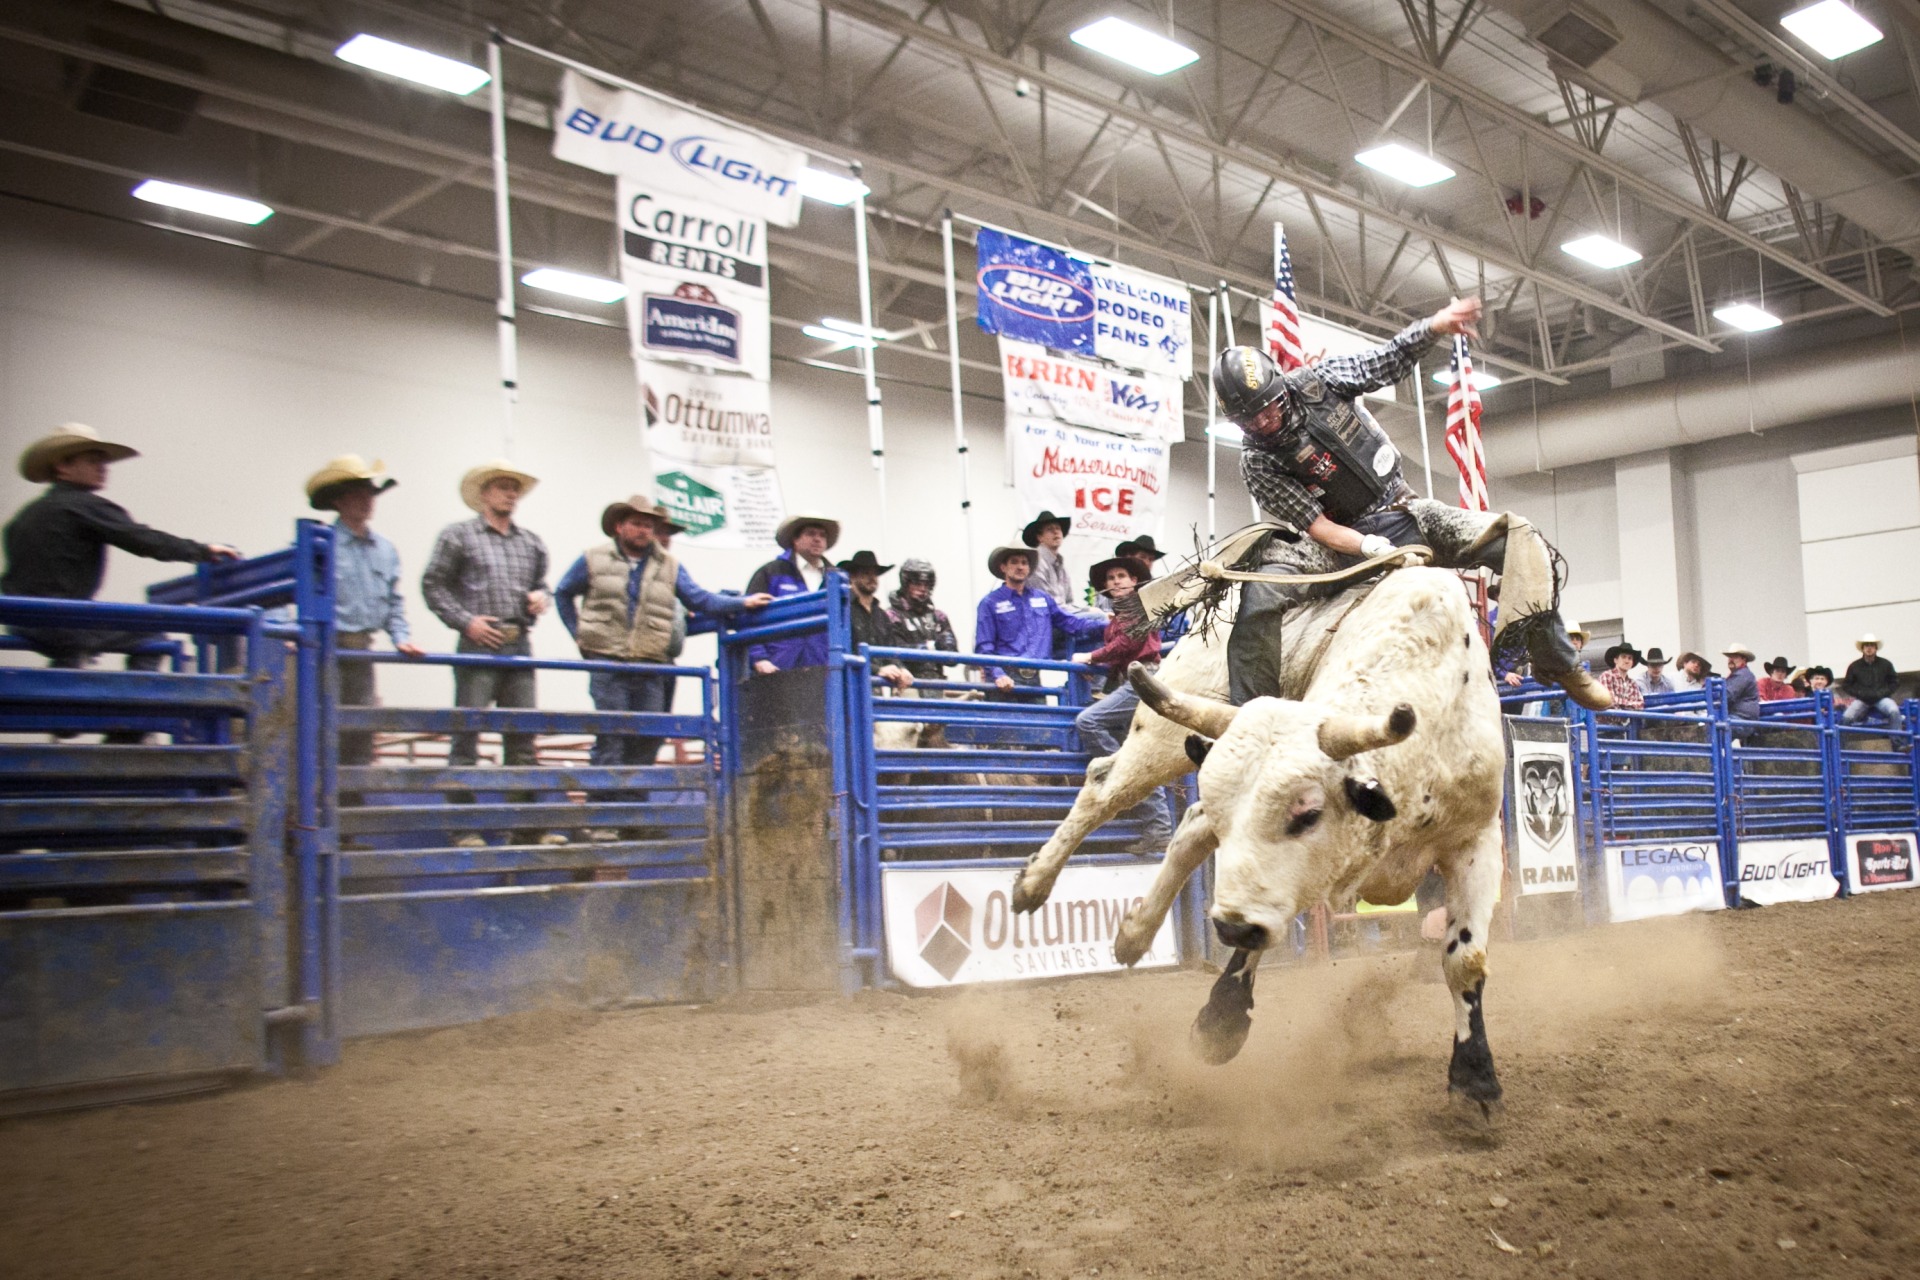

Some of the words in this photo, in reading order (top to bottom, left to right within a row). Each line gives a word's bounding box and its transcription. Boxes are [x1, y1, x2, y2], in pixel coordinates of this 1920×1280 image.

[565, 108, 665, 154] BUD
[689, 144, 797, 197] LIGHT
[631, 193, 756, 256] Carroll
[651, 241, 736, 279] RENTS
[991, 281, 1084, 314] LIGHT
[1005, 269, 1074, 299] BUD
[1095, 275, 1190, 315] WELCOME
[1097, 298, 1165, 329] RODEO
[1097, 322, 1150, 348] FANS
[665, 393, 771, 436] Ottumwa
[1075, 486, 1135, 516] ICE
[1620, 845, 1710, 867] LEGACY
[1522, 865, 1575, 886] RAM
[1740, 864, 1777, 883] BUD
[1783, 860, 1829, 880] LIGHT
[1013, 948, 1098, 974] SAVINGS
